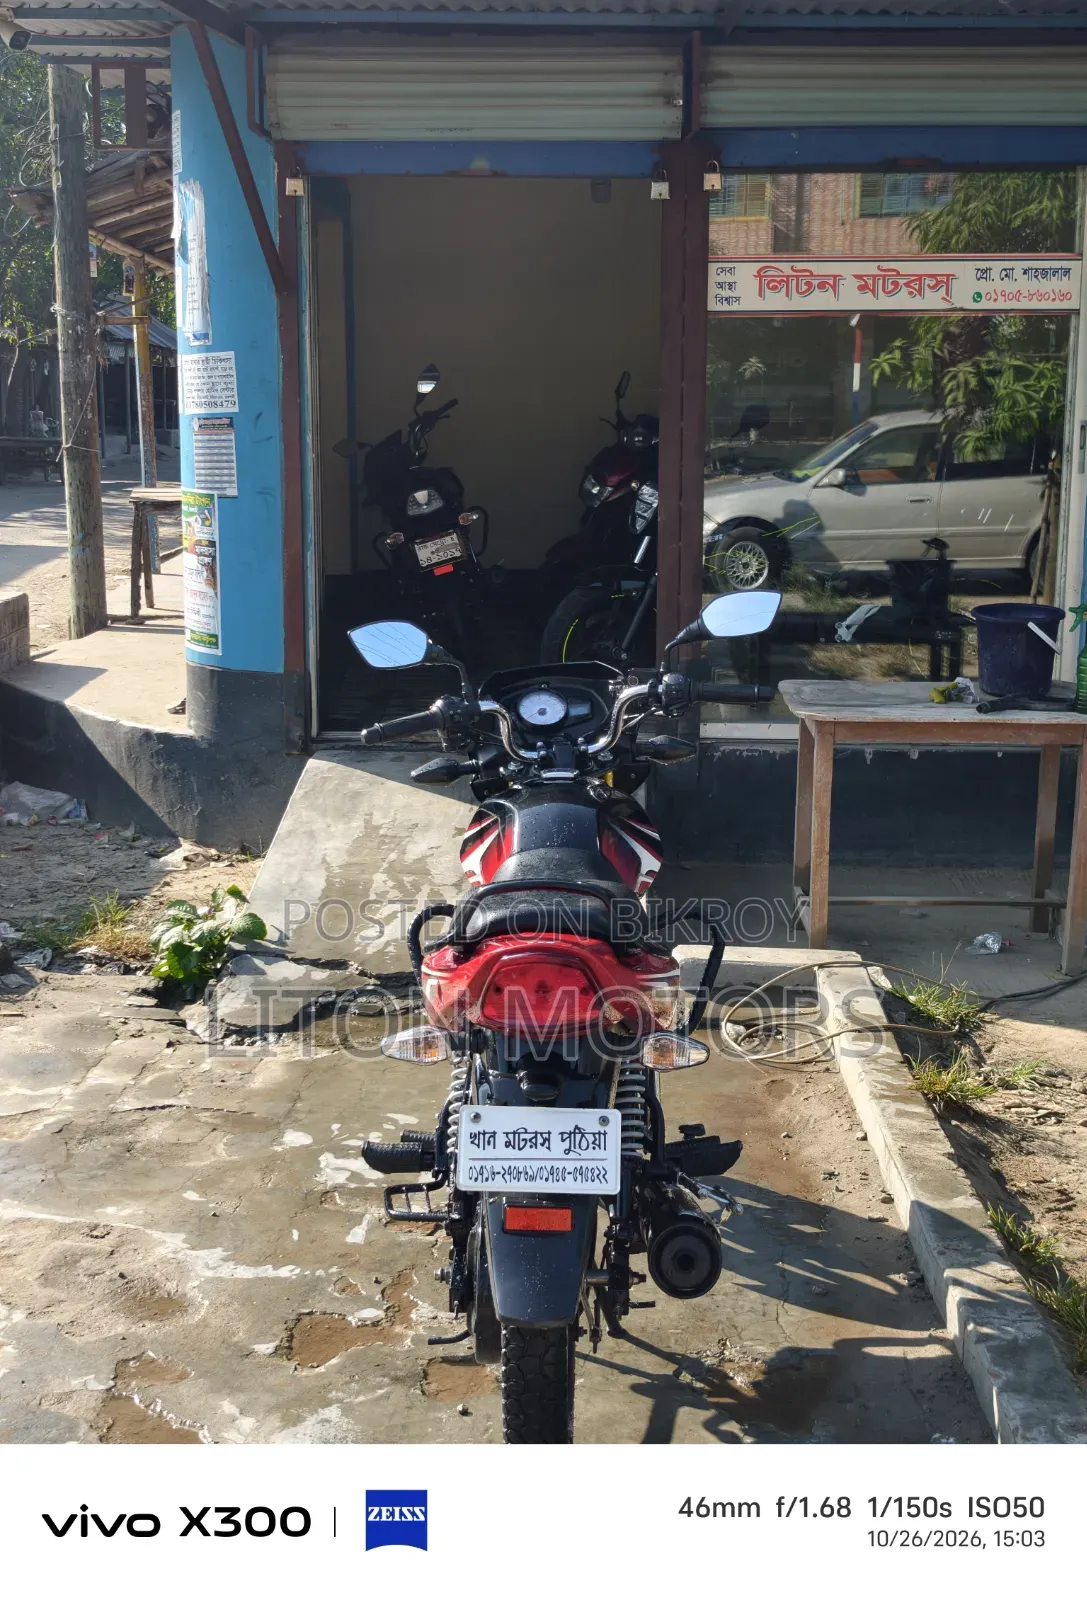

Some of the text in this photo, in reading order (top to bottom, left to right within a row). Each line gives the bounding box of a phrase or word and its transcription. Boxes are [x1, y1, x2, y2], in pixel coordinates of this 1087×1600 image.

[715, 265, 736, 277] সেবা
[975, 265, 1072, 283] প্রো. মো. শাহজালাল
[715, 279, 738, 292] আস্থা
[753, 264, 958, 307] লিটন মটরস্
[714, 293, 741, 307] বিশ্বাস
[984, 288, 1073, 303] ০১৭০৫-৮৬০১৬০
[186, 400, 237, 409] 780508479
[469, 1124, 608, 1156] খান মটরস্ পুঠিয়া
